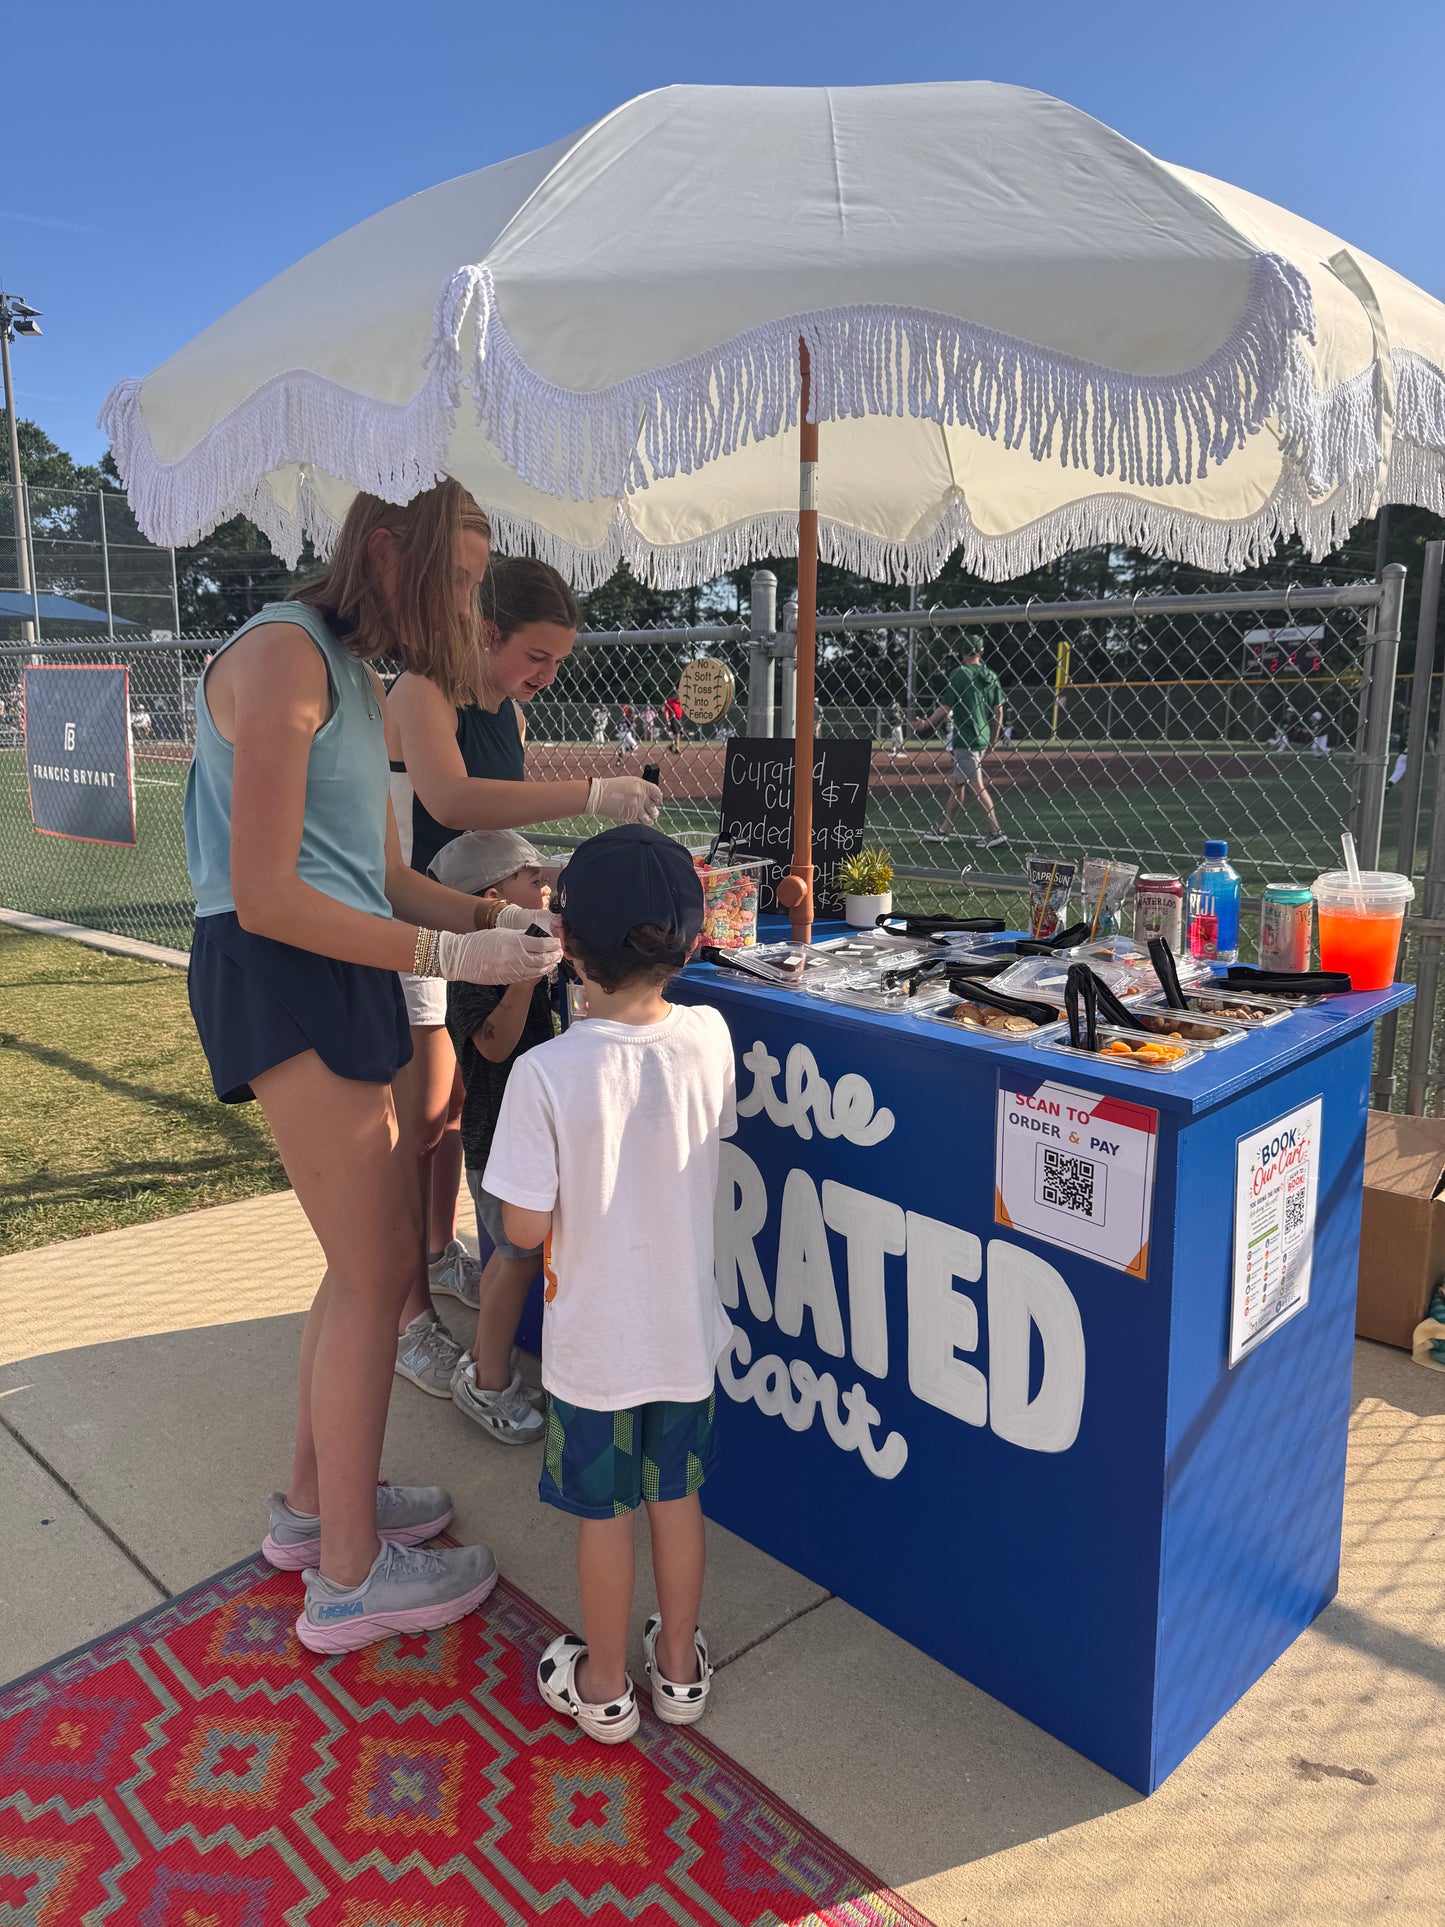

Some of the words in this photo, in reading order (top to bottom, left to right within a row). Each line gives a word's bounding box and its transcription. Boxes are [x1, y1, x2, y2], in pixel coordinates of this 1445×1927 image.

[694, 671, 712, 681] Soft
[697, 659, 709, 669] No
[692, 683, 713, 694] Toss
[694, 696, 709, 707] Into
[689, 709, 714, 720] Fence
[33, 764, 70, 782] FRANCIS
[73, 770, 116, 788] BRYANT
[731, 751, 827, 790] Curatd
[765, 783, 793, 810] Cu
[1032, 870, 1053, 883] CAPR
[1053, 872, 1072, 886] SUN
[737, 1040, 895, 1147] the
[1015, 1093, 1060, 1117] SCAN
[1066, 1107, 1090, 1125] TO
[1009, 1112, 1061, 1138] ORDER
[1068, 1131, 1080, 1145] &
[1090, 1136, 1120, 1156] PAY
[1262, 1128, 1297, 1166] BOOK
[1253, 1164, 1277, 1196] Our
[1278, 1137, 1306, 1175] Cart
[319, 1601, 364, 1619] HOKA
